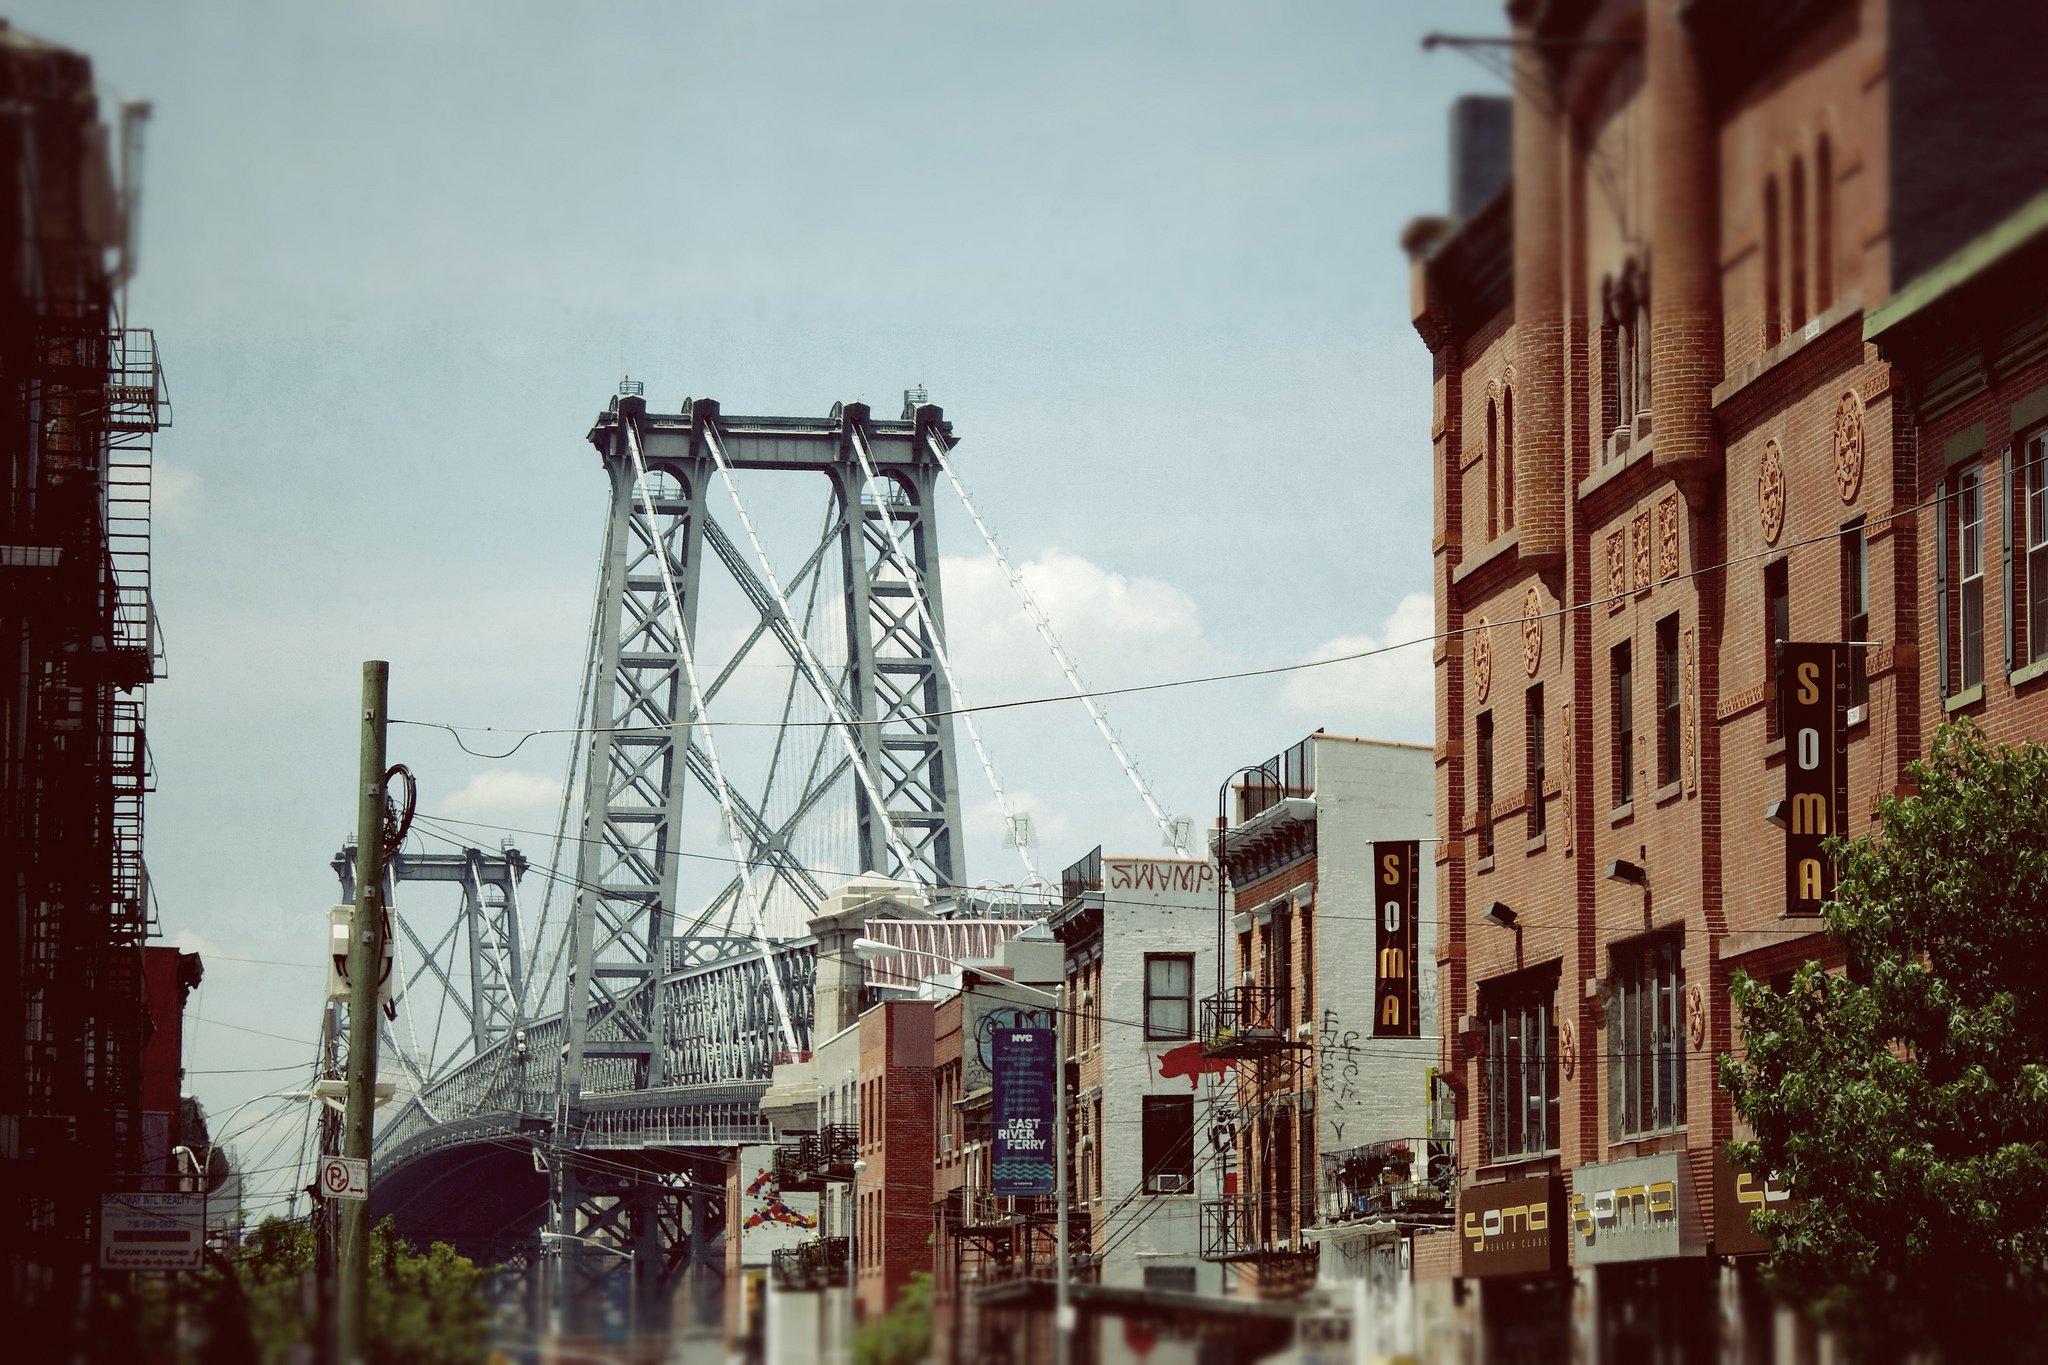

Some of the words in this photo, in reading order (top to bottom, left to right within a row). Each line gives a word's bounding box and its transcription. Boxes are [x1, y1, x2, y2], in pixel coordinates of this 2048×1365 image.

[1836, 662, 1847, 754] CLUBS
[1410, 851, 1419, 920] CLUBS
[1410, 942, 1419, 1026] HEALTH
[1011, 1034, 1033, 1042] NYC
[1008, 1118, 1041, 1129] EAST
[998, 1128, 1035, 1140] RIVER
[1007, 1139, 1046, 1150] FERRY
[162, 1194, 191, 1205] REALTY
[1485, 1240, 1515, 1252] HEALTH
[1521, 1236, 1548, 1248] CLUBS
[161, 1249, 190, 1257] CORNER
